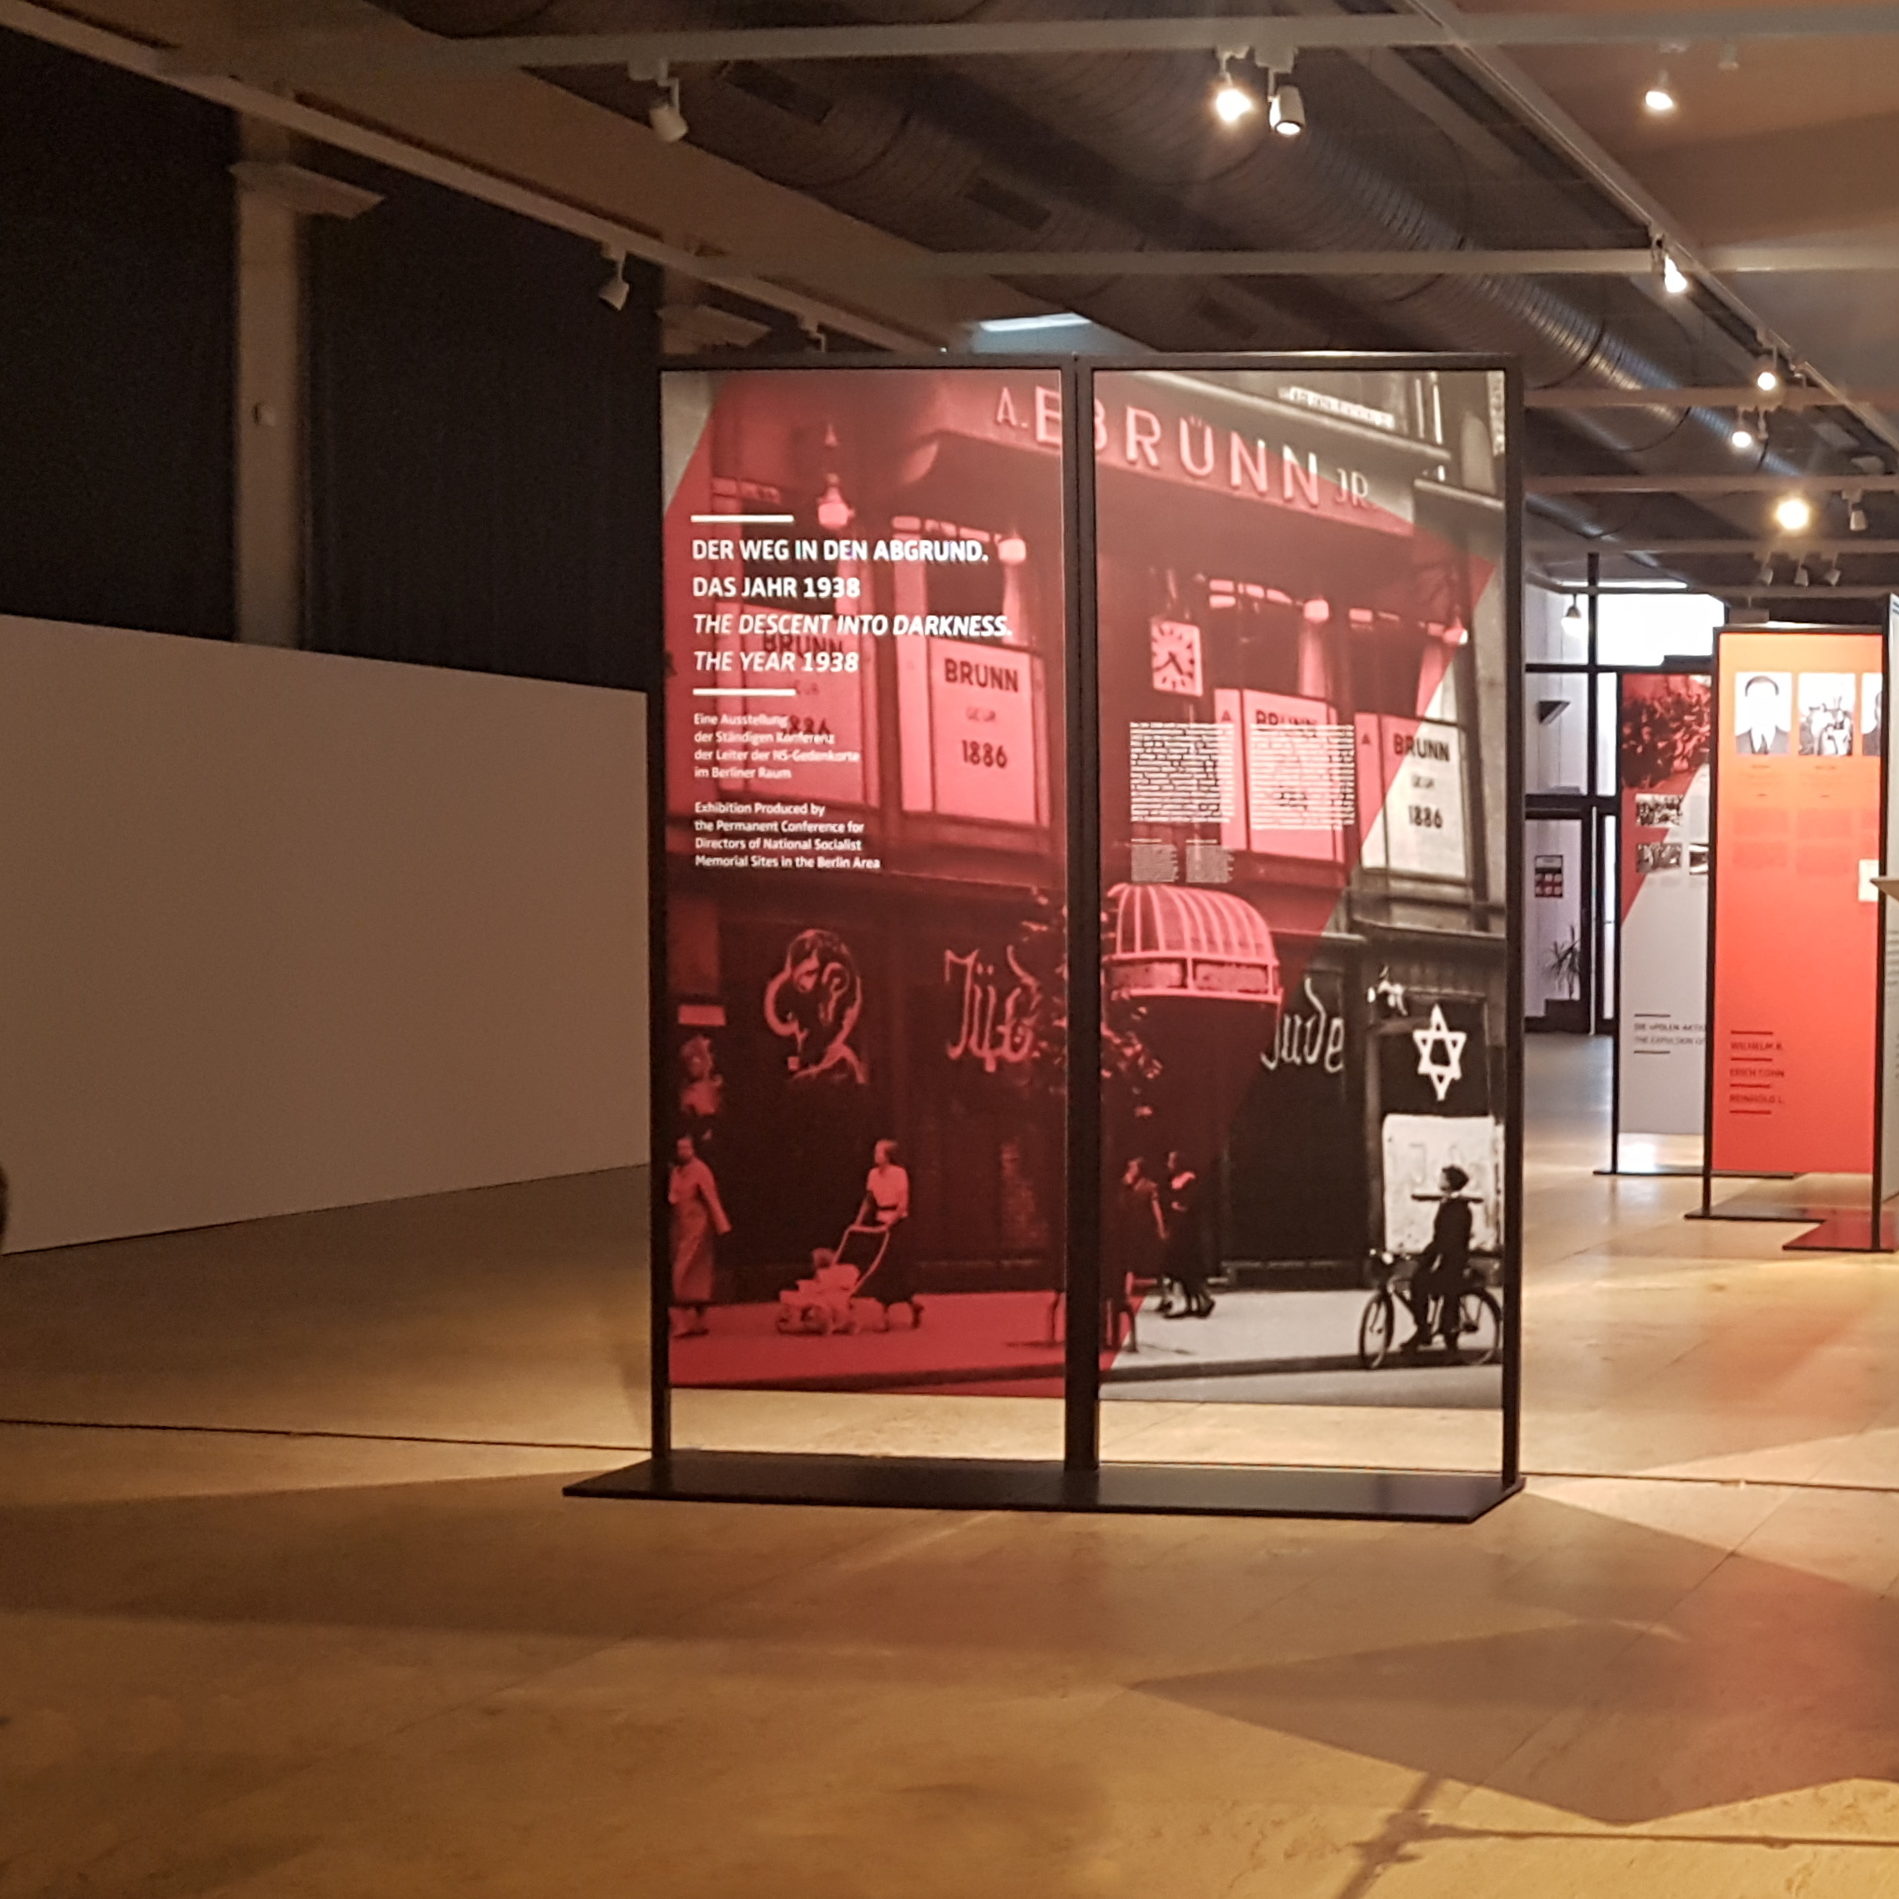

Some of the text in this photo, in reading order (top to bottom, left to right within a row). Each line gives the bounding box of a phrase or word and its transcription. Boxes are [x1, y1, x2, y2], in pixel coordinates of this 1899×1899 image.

[692, 539, 989, 562] DER WEG IN DEN ABGRUND.
[692, 576, 861, 598] DAS JAHR 1938
[693, 613, 1013, 637] THE DESCENT INTO DARKNESS.
[693, 651, 860, 673] THE YEAR 1938
[944, 657, 1018, 693] BRUNN
[693, 713, 790, 728] Eine Ausstellung
[694, 732, 713, 743] der
[716, 731, 774, 746] Ständigen
[694, 750, 713, 761] der
[716, 750, 749, 761] Leiter
[751, 750, 770, 761] der
[962, 739, 1008, 769] 1886
[694, 766, 792, 779] im Berliner Raum
[695, 801, 826, 817] Exhibition Produced by
[1408, 804, 1443, 829] 1886
[694, 820, 865, 833] the Permanent Conference for
[695, 837, 862, 851] Directors of National Socialist
[695, 855, 881, 869] Memorial Sites in the Berlin Area
